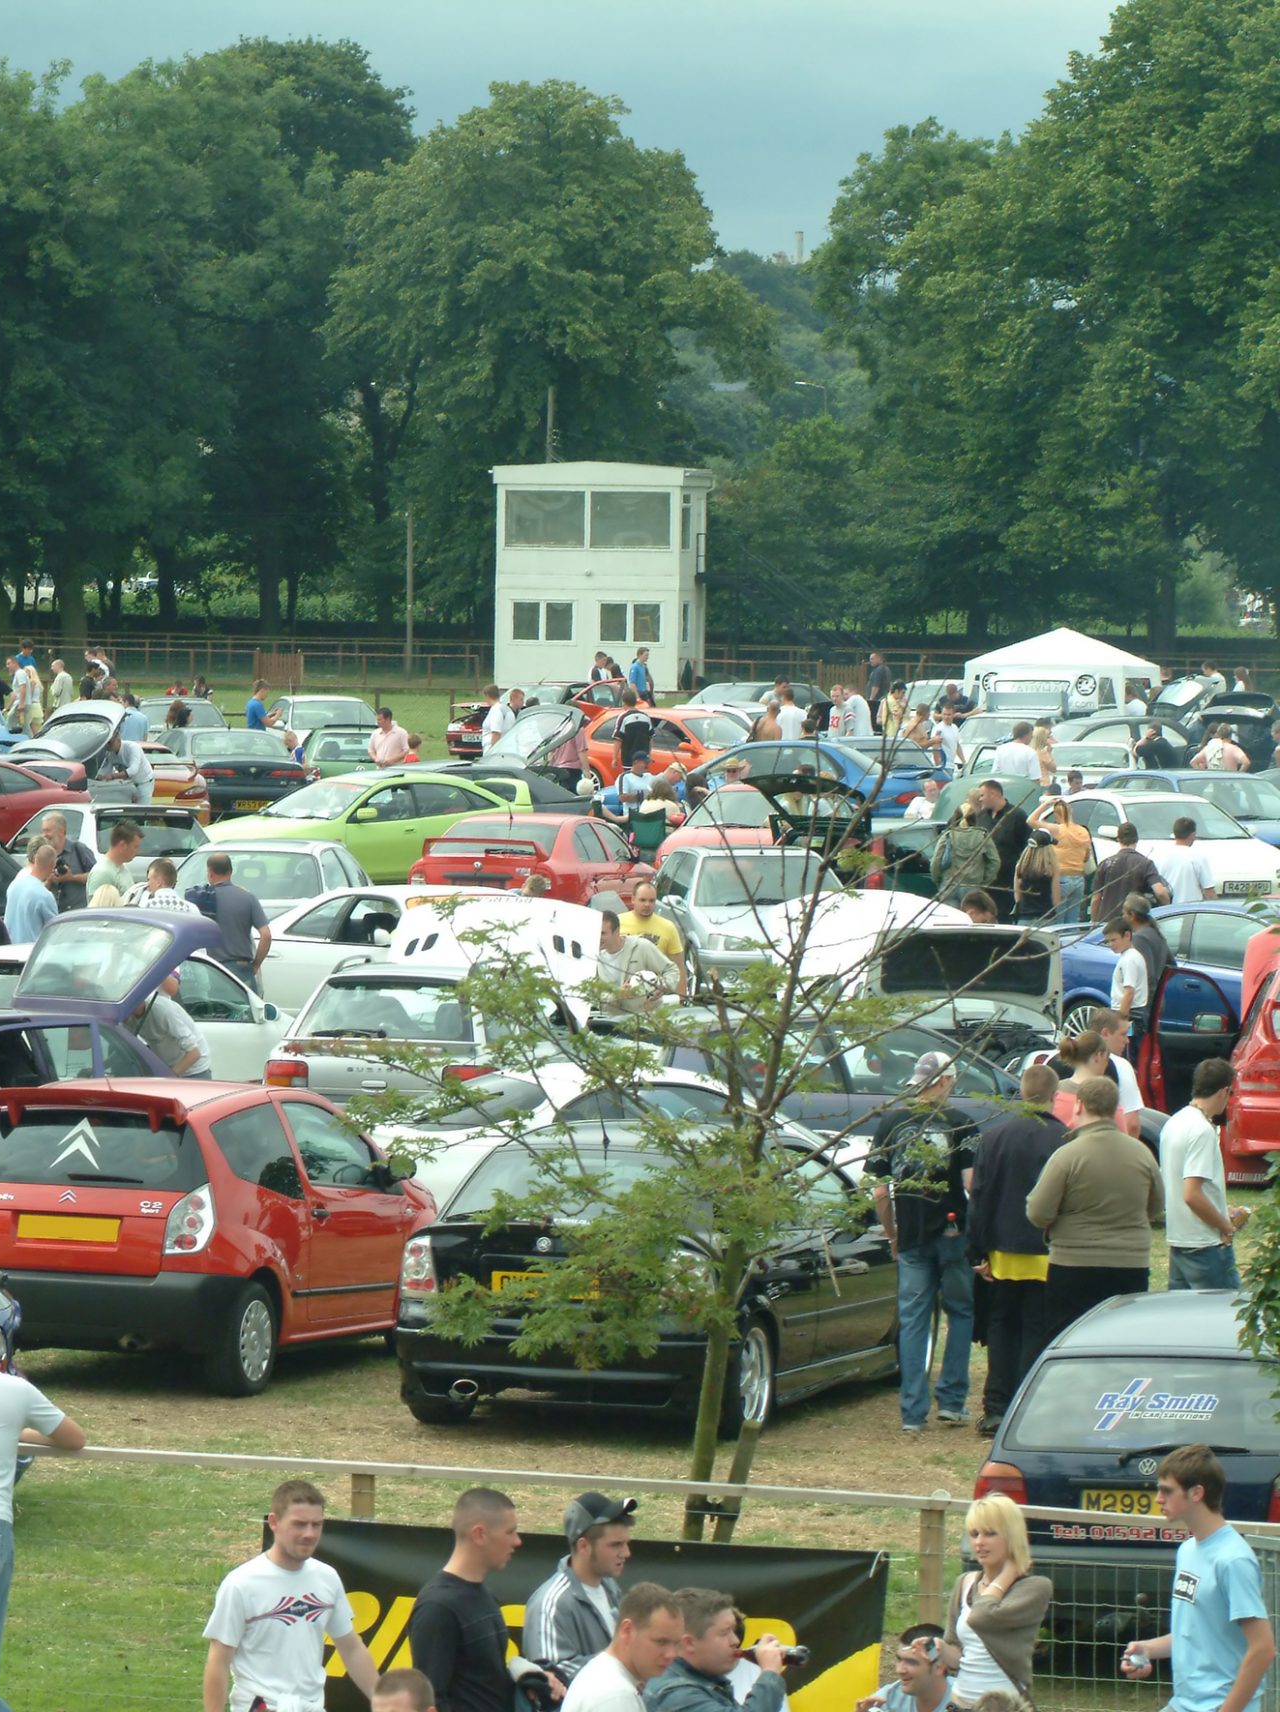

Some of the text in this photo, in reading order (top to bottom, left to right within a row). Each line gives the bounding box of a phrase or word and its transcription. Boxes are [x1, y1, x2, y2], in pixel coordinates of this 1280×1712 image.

[139, 1200, 163, 1209] C2
[1095, 1392, 1219, 1412] Ray Smith
[1085, 1491, 1152, 1515] M299
[1050, 1524, 1087, 1540] Tel:
[1089, 1525, 1156, 1541] 01592
